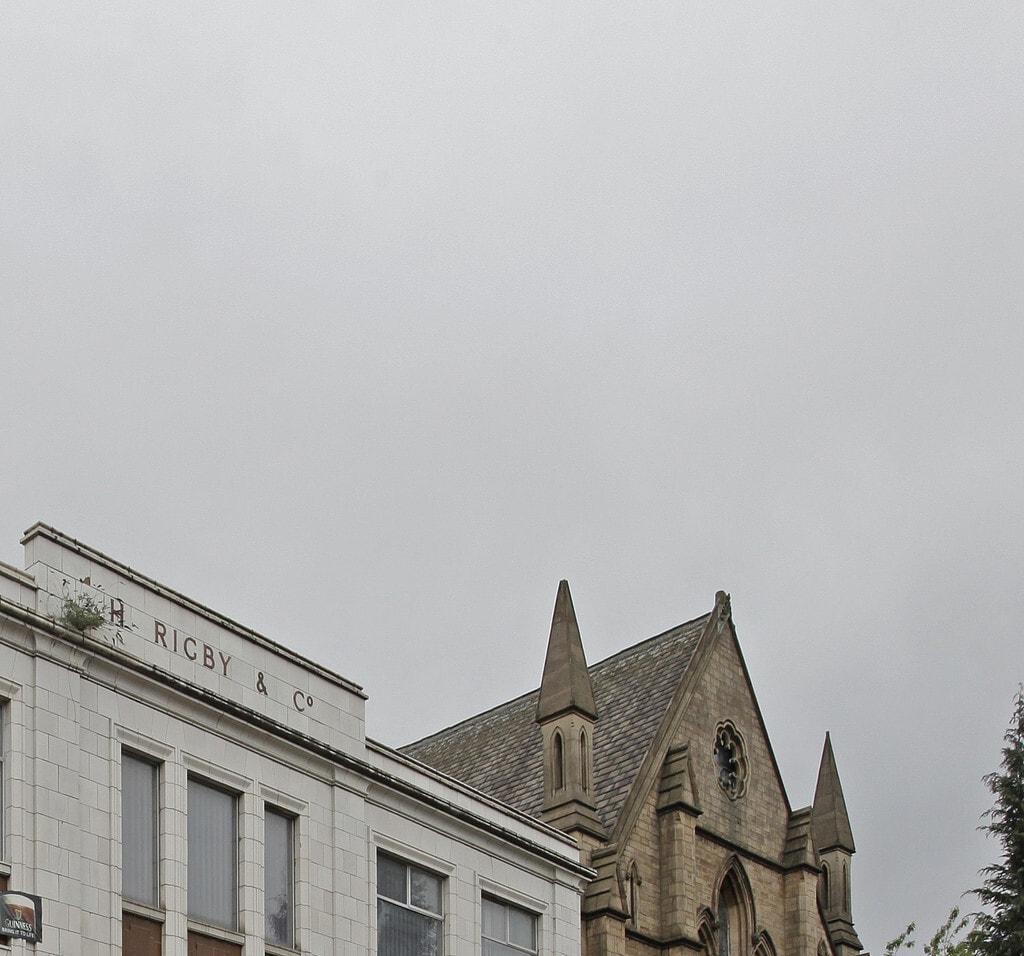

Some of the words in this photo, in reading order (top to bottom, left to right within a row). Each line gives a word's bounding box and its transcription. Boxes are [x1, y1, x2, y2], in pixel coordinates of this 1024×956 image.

[257, 671, 268, 696] &
[1, 927, 15, 935] BRING
[5, 918, 33, 932] GUINNESS
